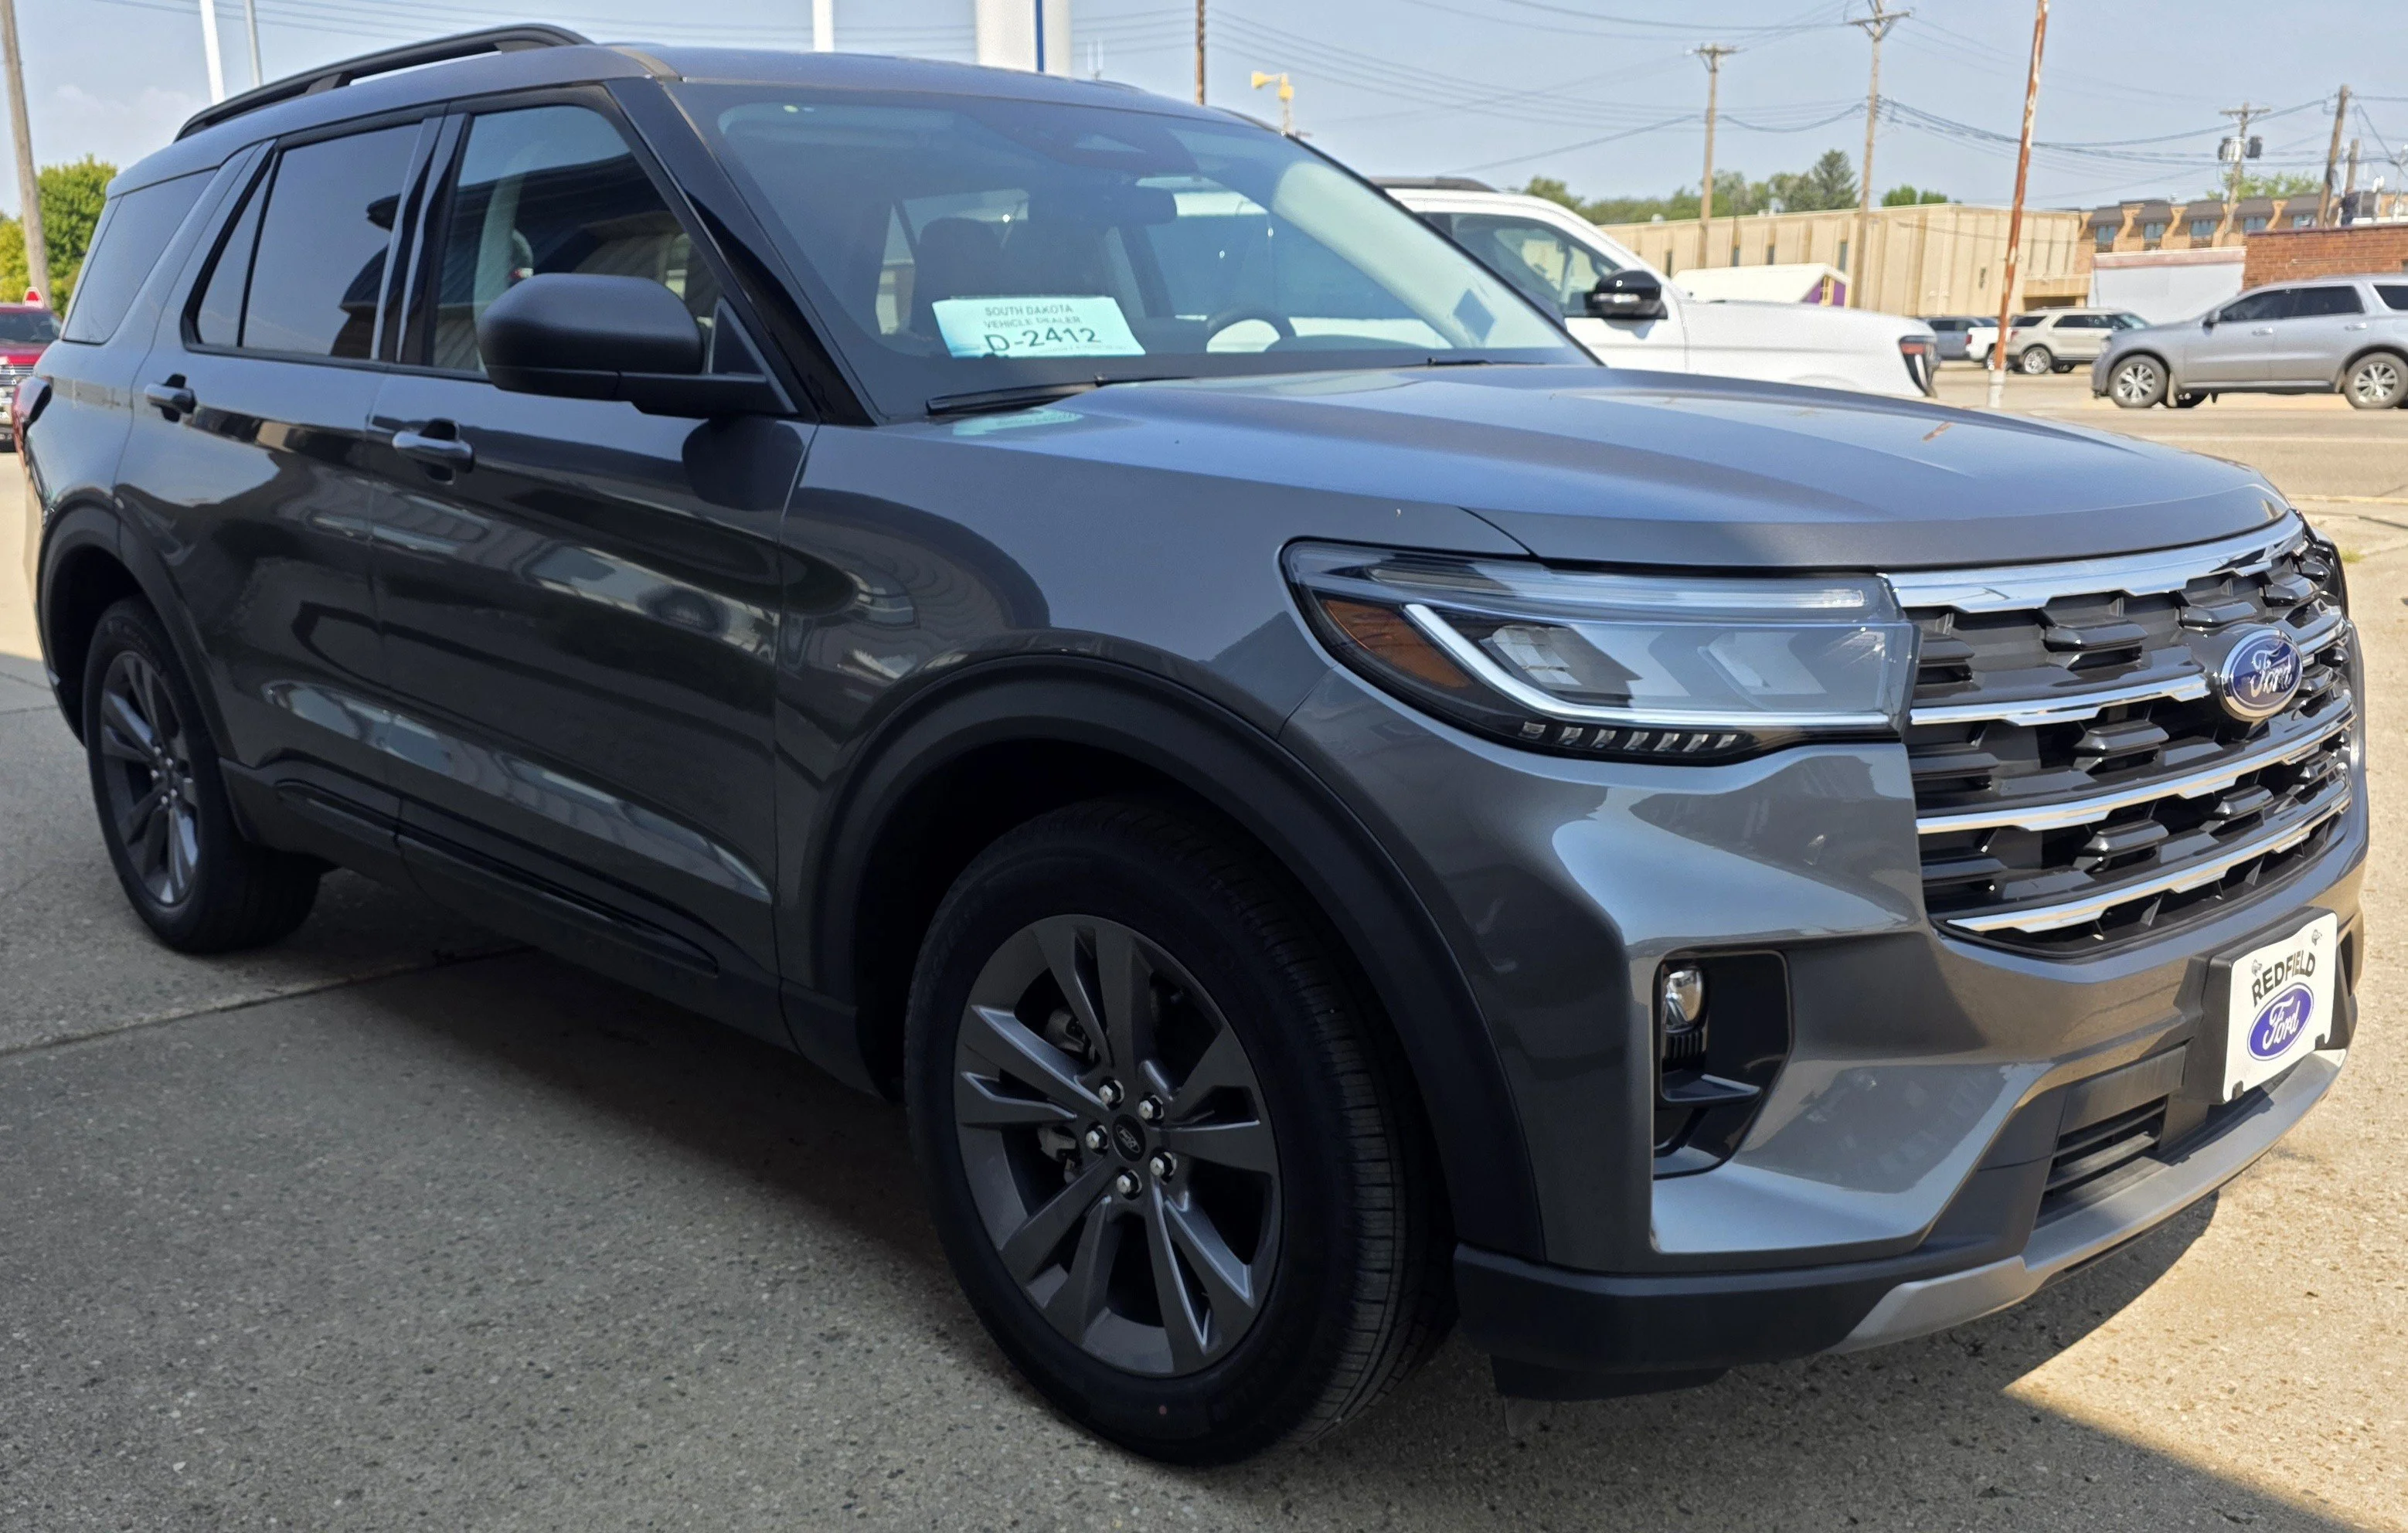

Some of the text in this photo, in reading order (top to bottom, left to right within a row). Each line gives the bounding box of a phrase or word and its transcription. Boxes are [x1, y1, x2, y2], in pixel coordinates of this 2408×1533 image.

[983, 318, 1033, 329] VEHICLE
[985, 304, 1073, 317] SOUTH DAKOTA
[984, 327, 1102, 352] D-2412
[2250, 641, 2293, 698] Ford
[2251, 950, 2316, 1008] REDFIELD
[2262, 995, 2301, 1051] Ford
